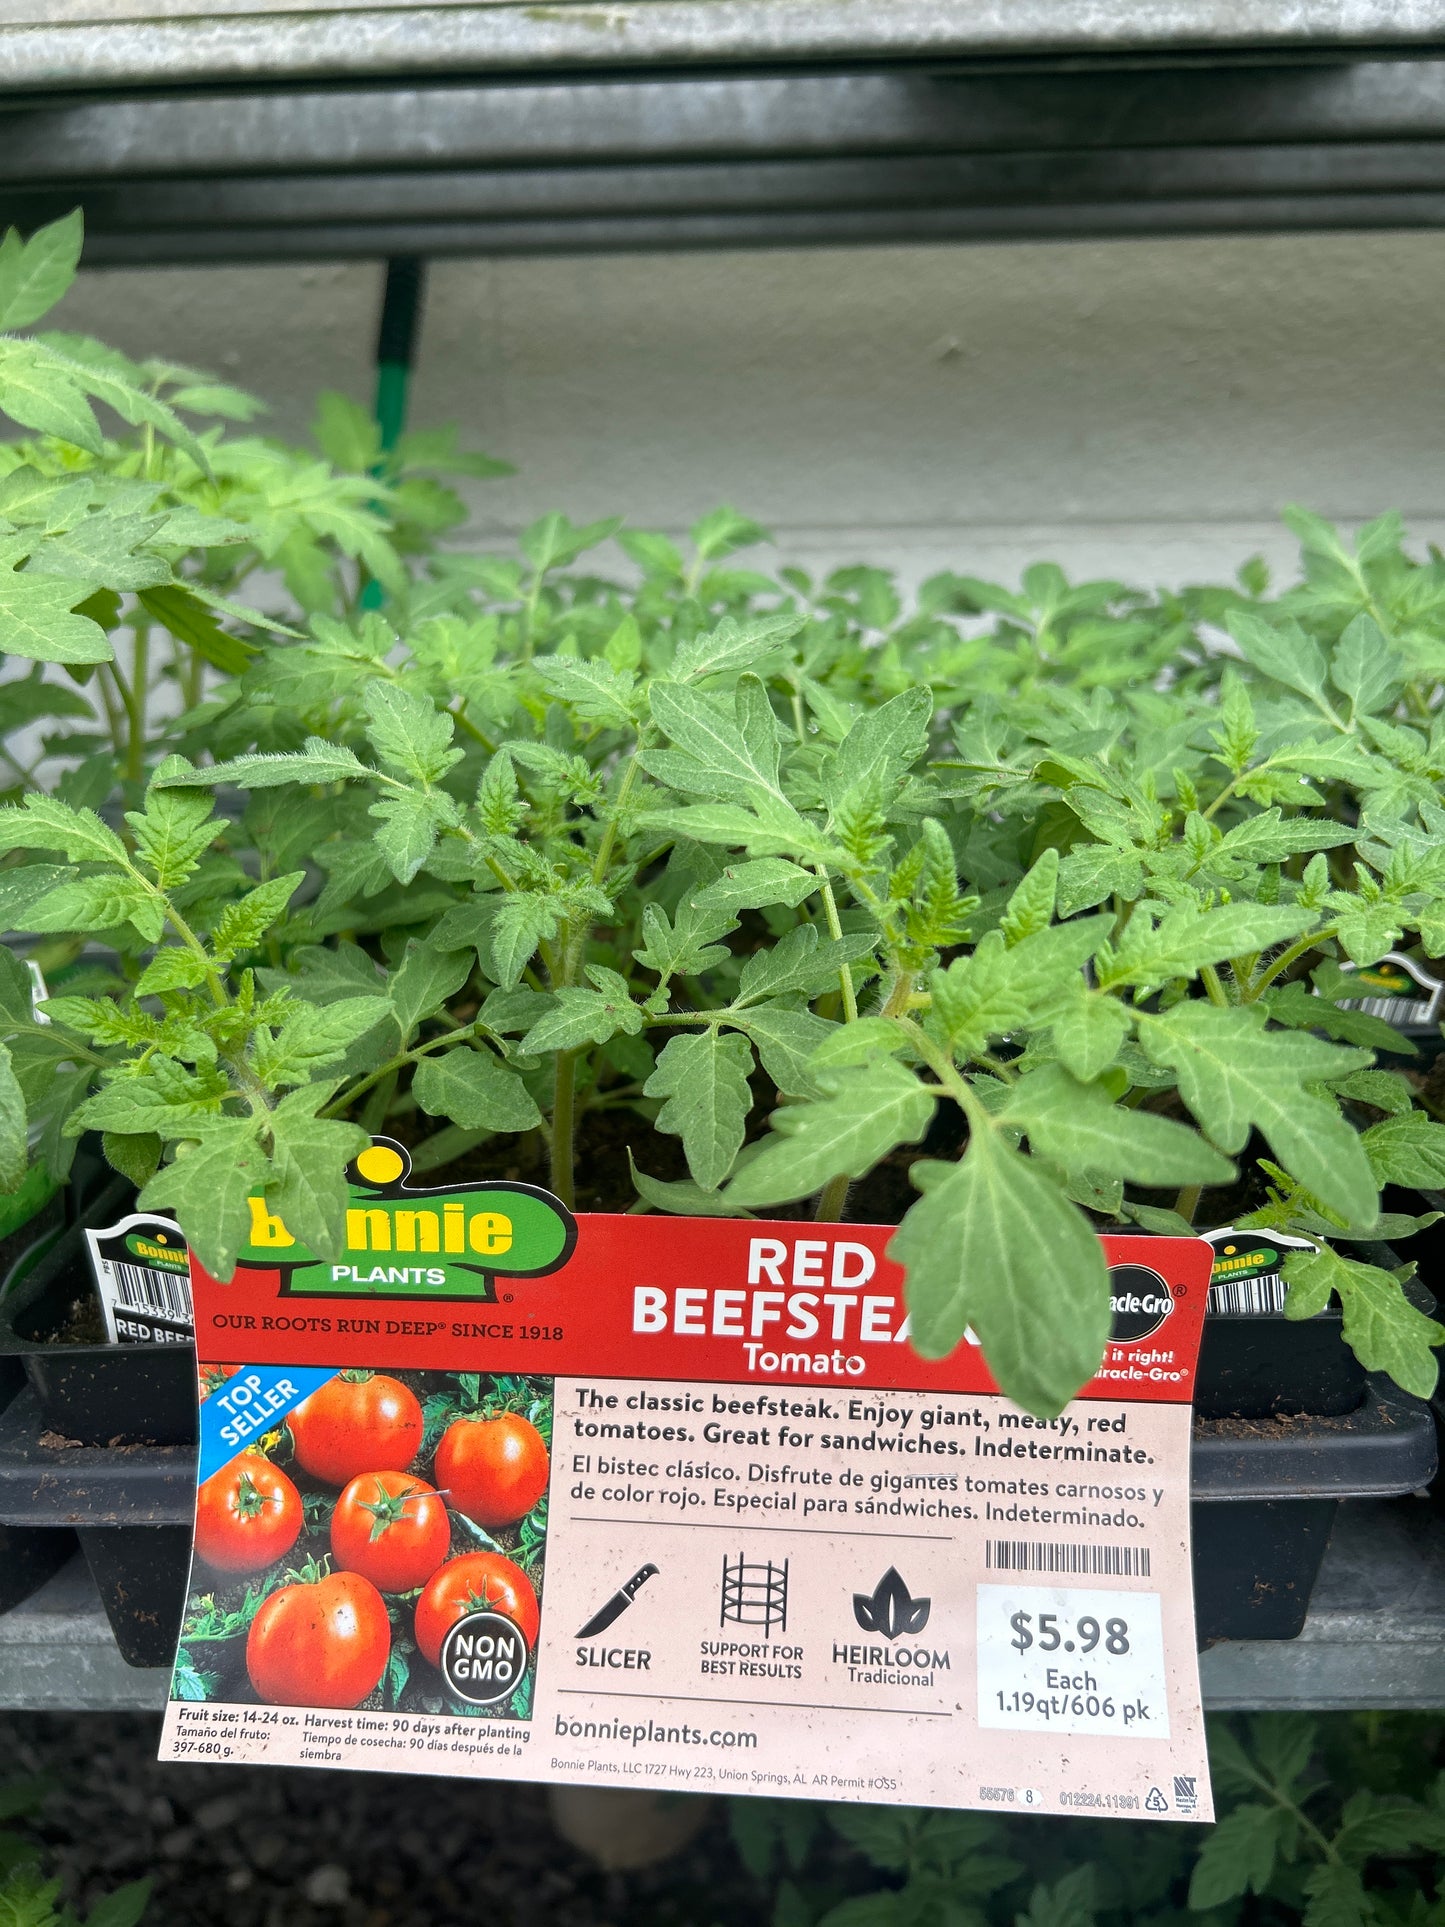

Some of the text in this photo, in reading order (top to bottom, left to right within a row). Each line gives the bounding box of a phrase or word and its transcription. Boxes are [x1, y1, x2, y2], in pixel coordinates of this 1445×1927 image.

[332, 1265, 446, 1285] PLANTS
[747, 1238, 877, 1288] RED
[1212, 1254, 1265, 1274] onnie
[1218, 1270, 1248, 1280] PLANTS
[135, 1303, 175, 1320] 15339
[633, 1286, 982, 1346] BEEFSTE
[115, 1318, 151, 1340] RED
[212, 1314, 256, 1331] OUR
[261, 1316, 332, 1333] ROOTS
[337, 1319, 381, 1335] RUN
[452, 1322, 514, 1339] SINCE
[518, 1325, 564, 1341] 1918
[743, 1343, 867, 1376] Tomato
[1112, 1348, 1124, 1361] it
[1128, 1348, 1174, 1366] right!
[216, 1375, 262, 1415] TOP
[220, 1379, 300, 1447] SELLER
[575, 1388, 619, 1409] The
[626, 1390, 704, 1413] classic
[712, 1393, 841, 1420] beefsteak.
[849, 1400, 914, 1429] Enjoy
[920, 1405, 991, 1432] giant,
[1087, 1413, 1127, 1433] red
[574, 1418, 1155, 1465] tomatoes. Great for sandwiches. Indeterminate.
[572, 1455, 1164, 1507] El bistec clásico. Disfrute de gigantes tomates carnosos y
[570, 1481, 1146, 1529] de color rojo. Especial para sándwiches. Indeterminado.
[1010, 1609, 1130, 1656] $5.98
[456, 1634, 515, 1658] NON
[575, 1646, 652, 1671] SLICER
[700, 1641, 804, 1662] SUPPORT FOR
[832, 1643, 952, 1671] HEIRLOOM
[454, 1658, 511, 1681] GMO
[701, 1660, 802, 1680] BEST RESULTS
[847, 1666, 935, 1687] Tradicional
[1046, 1668, 1098, 1691] Each
[178, 1708, 300, 1727] Fruit size: 14-24 oz.
[996, 1690, 1151, 1725] 1.19qt/606 pk
[176, 1725, 271, 1741] Tamaño del fruto:
[304, 1714, 532, 1743] Harvest time: 90 days after planting
[554, 1714, 759, 1748] bonnieplants.com
[173, 1741, 235, 1758] 397-680 g.
[299, 1747, 342, 1761] siembra
[302, 1731, 523, 1757] Tiempo de cosecha: 90 días después de la
[551, 1758, 585, 1770] Bonnie
[587, 1760, 621, 1774] Plants,
[623, 1762, 642, 1774] LLC
[644, 1763, 667, 1775] 1727
[669, 1765, 692, 1780] Hwy
[693, 1767, 717, 1780] 223,
[718, 1768, 748, 1781] Union
[751, 1770, 791, 1787] Springs,
[793, 1773, 807, 1785] AL
[812, 1774, 828, 1786] AR
[831, 1775, 865, 1789] Permit
[980, 1786, 1015, 1803] 55576
[1026, 1789, 1033, 1804] 8
